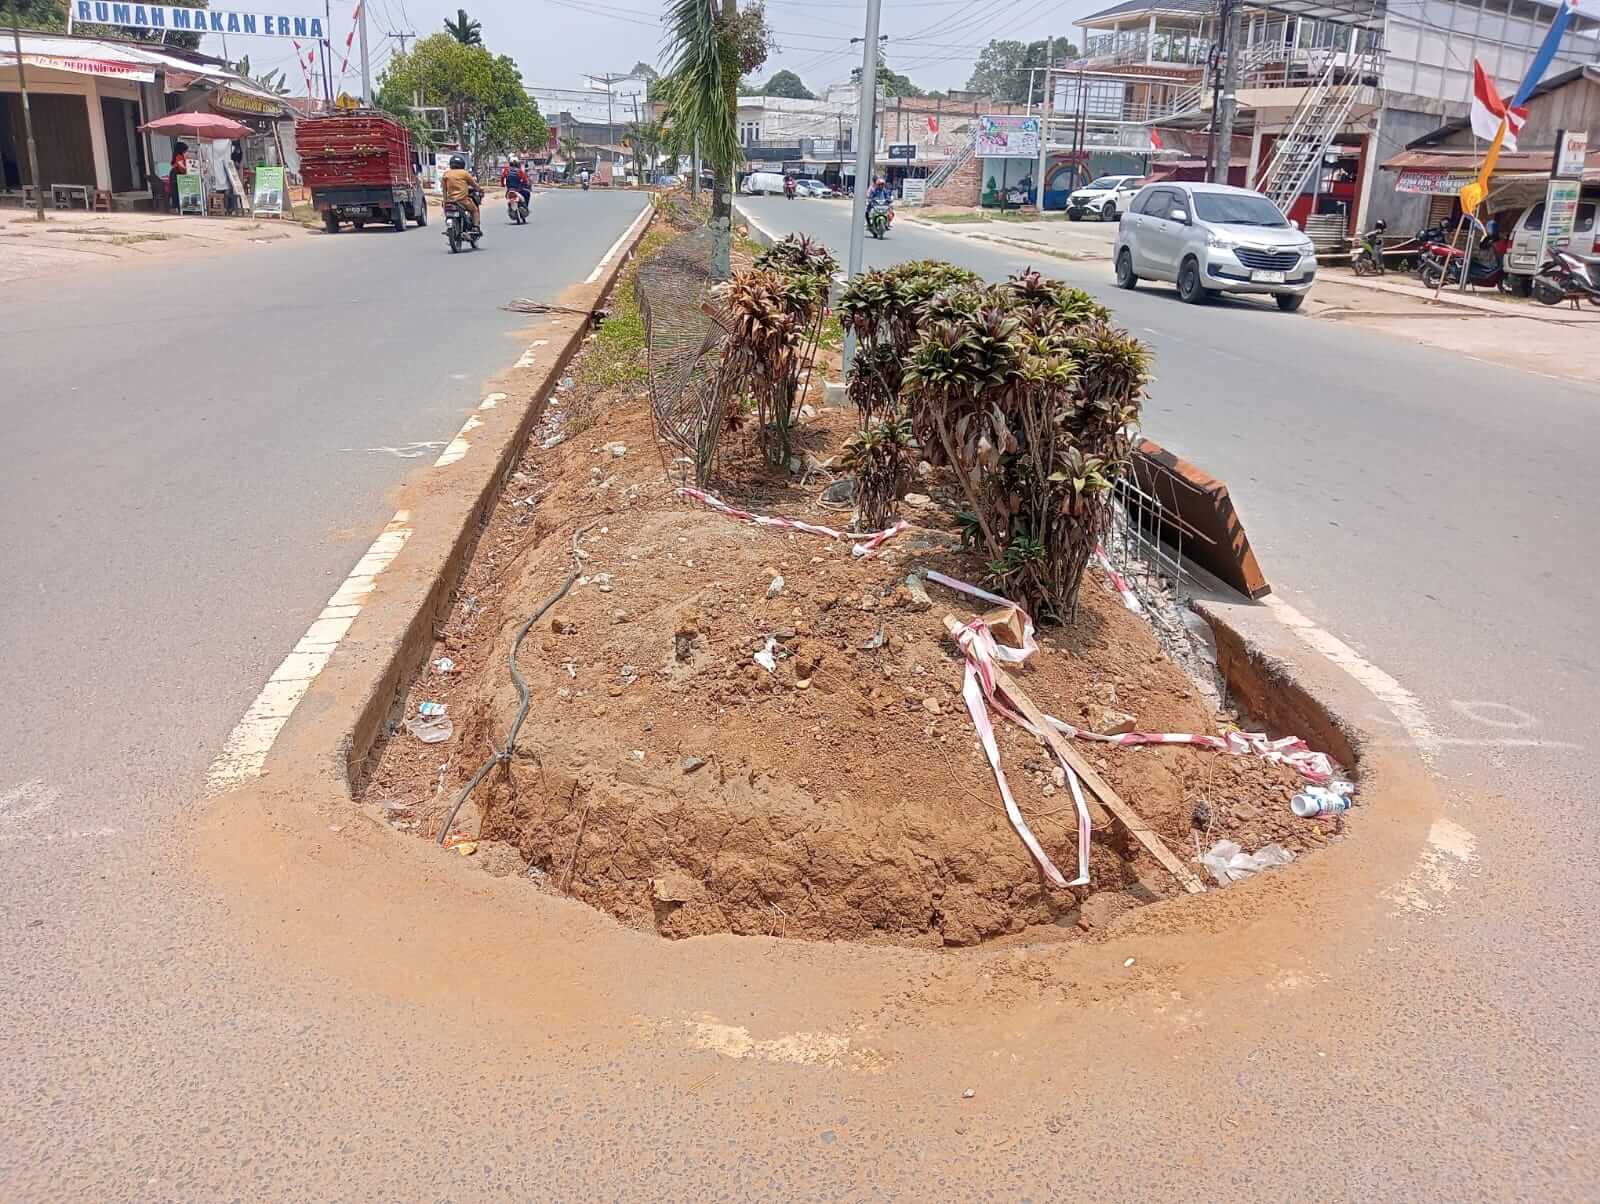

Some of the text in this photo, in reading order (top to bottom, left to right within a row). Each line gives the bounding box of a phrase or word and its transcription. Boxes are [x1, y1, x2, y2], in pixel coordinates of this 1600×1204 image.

[78, 1, 323, 38] RUMAH MAKAN ERNA
